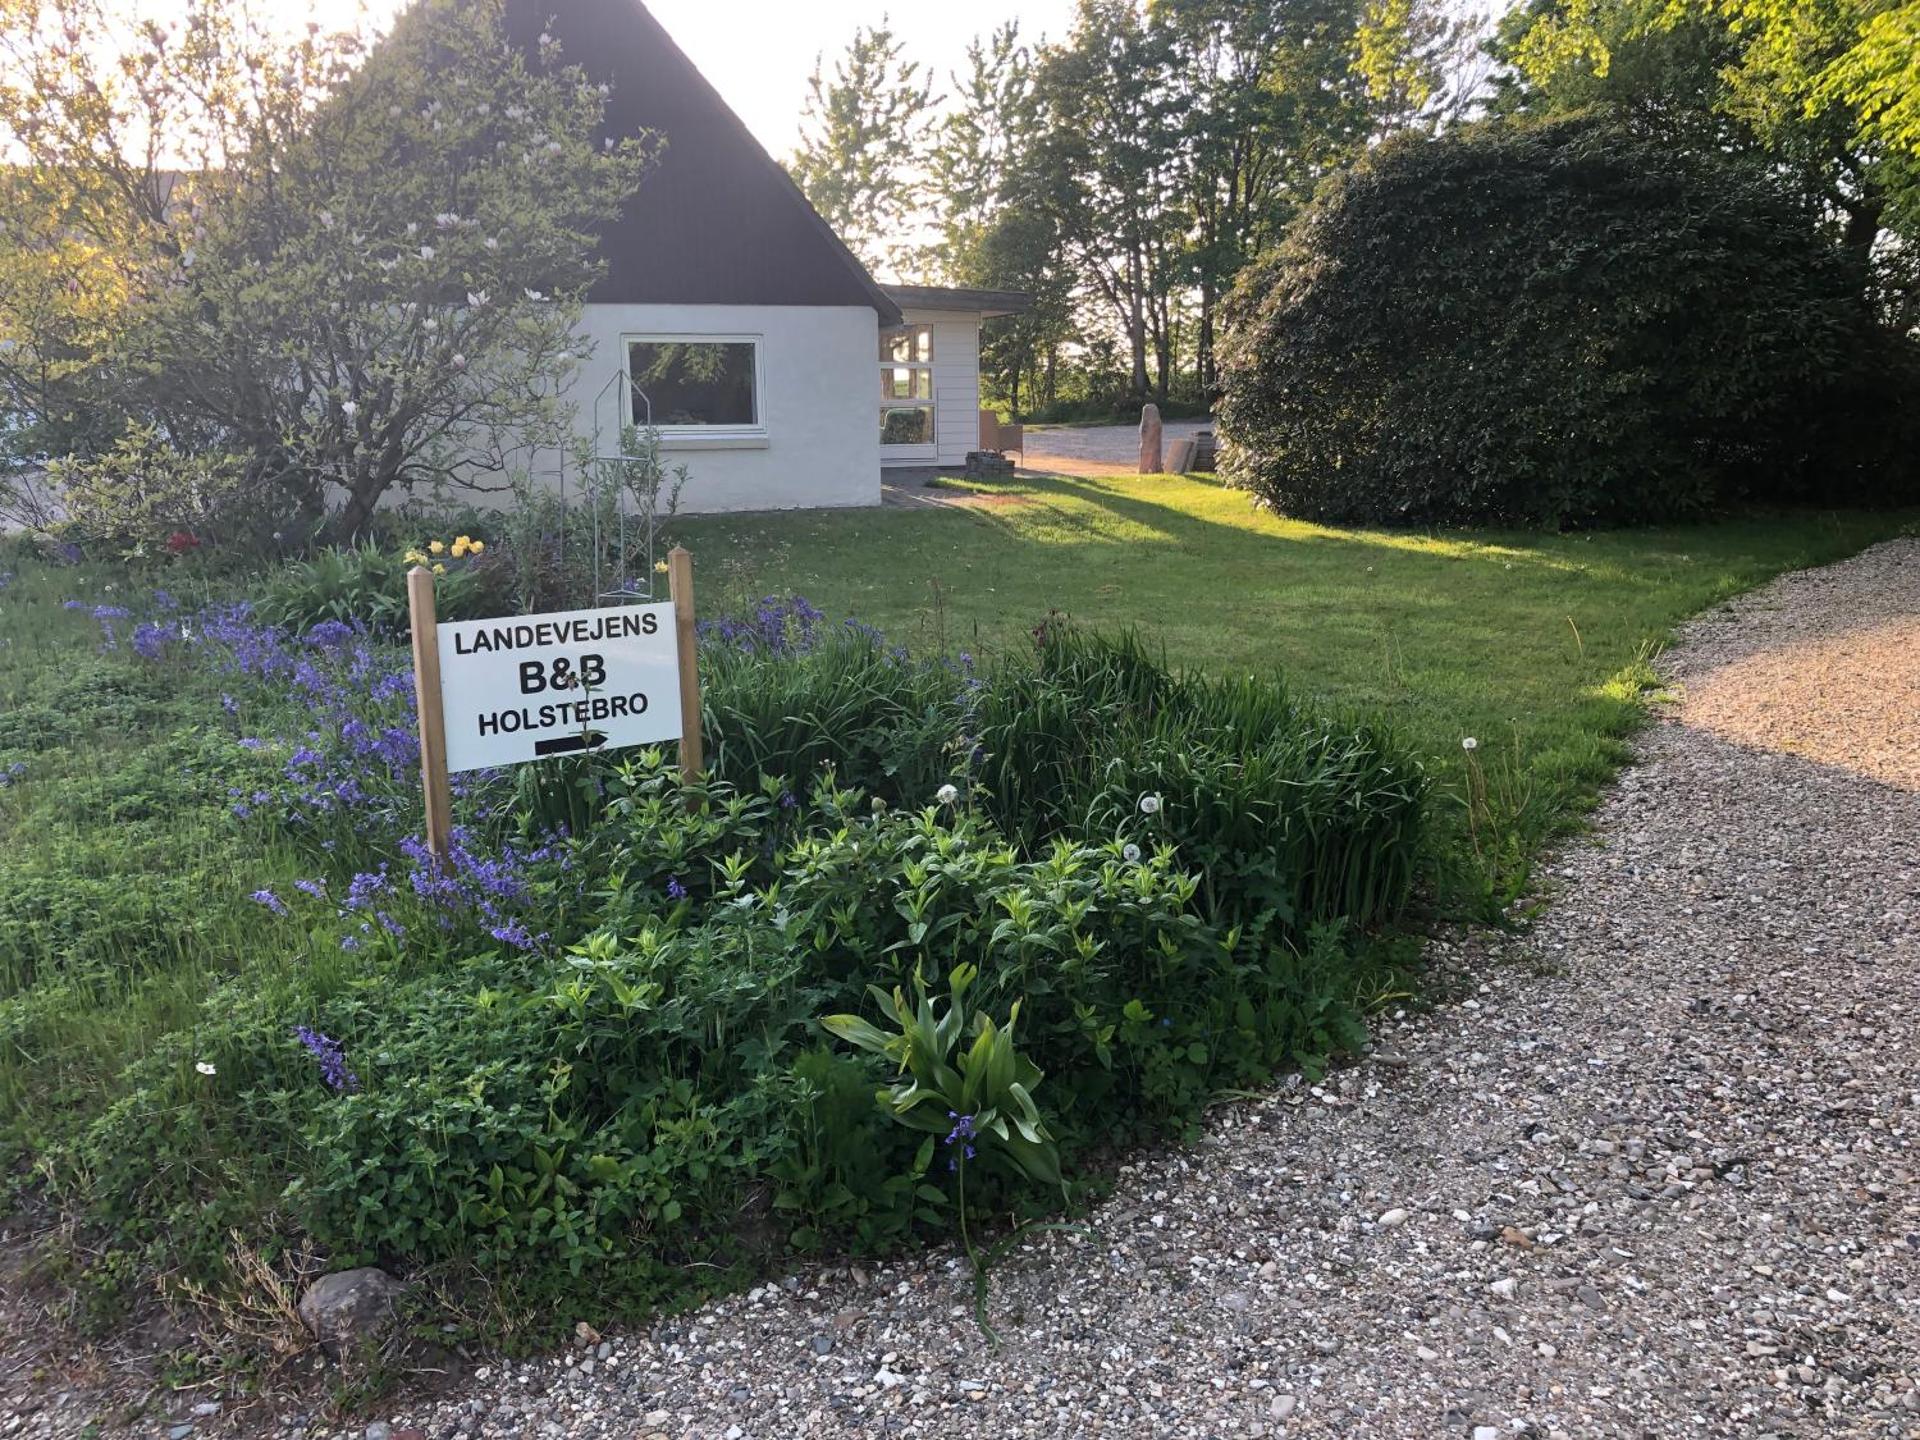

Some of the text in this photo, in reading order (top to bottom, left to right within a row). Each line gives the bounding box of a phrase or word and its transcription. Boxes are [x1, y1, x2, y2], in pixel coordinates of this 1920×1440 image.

[455, 613, 658, 654] LANDEVEJENS
[519, 654, 606, 694] B&B
[479, 693, 648, 736] HOLSTEBRO
